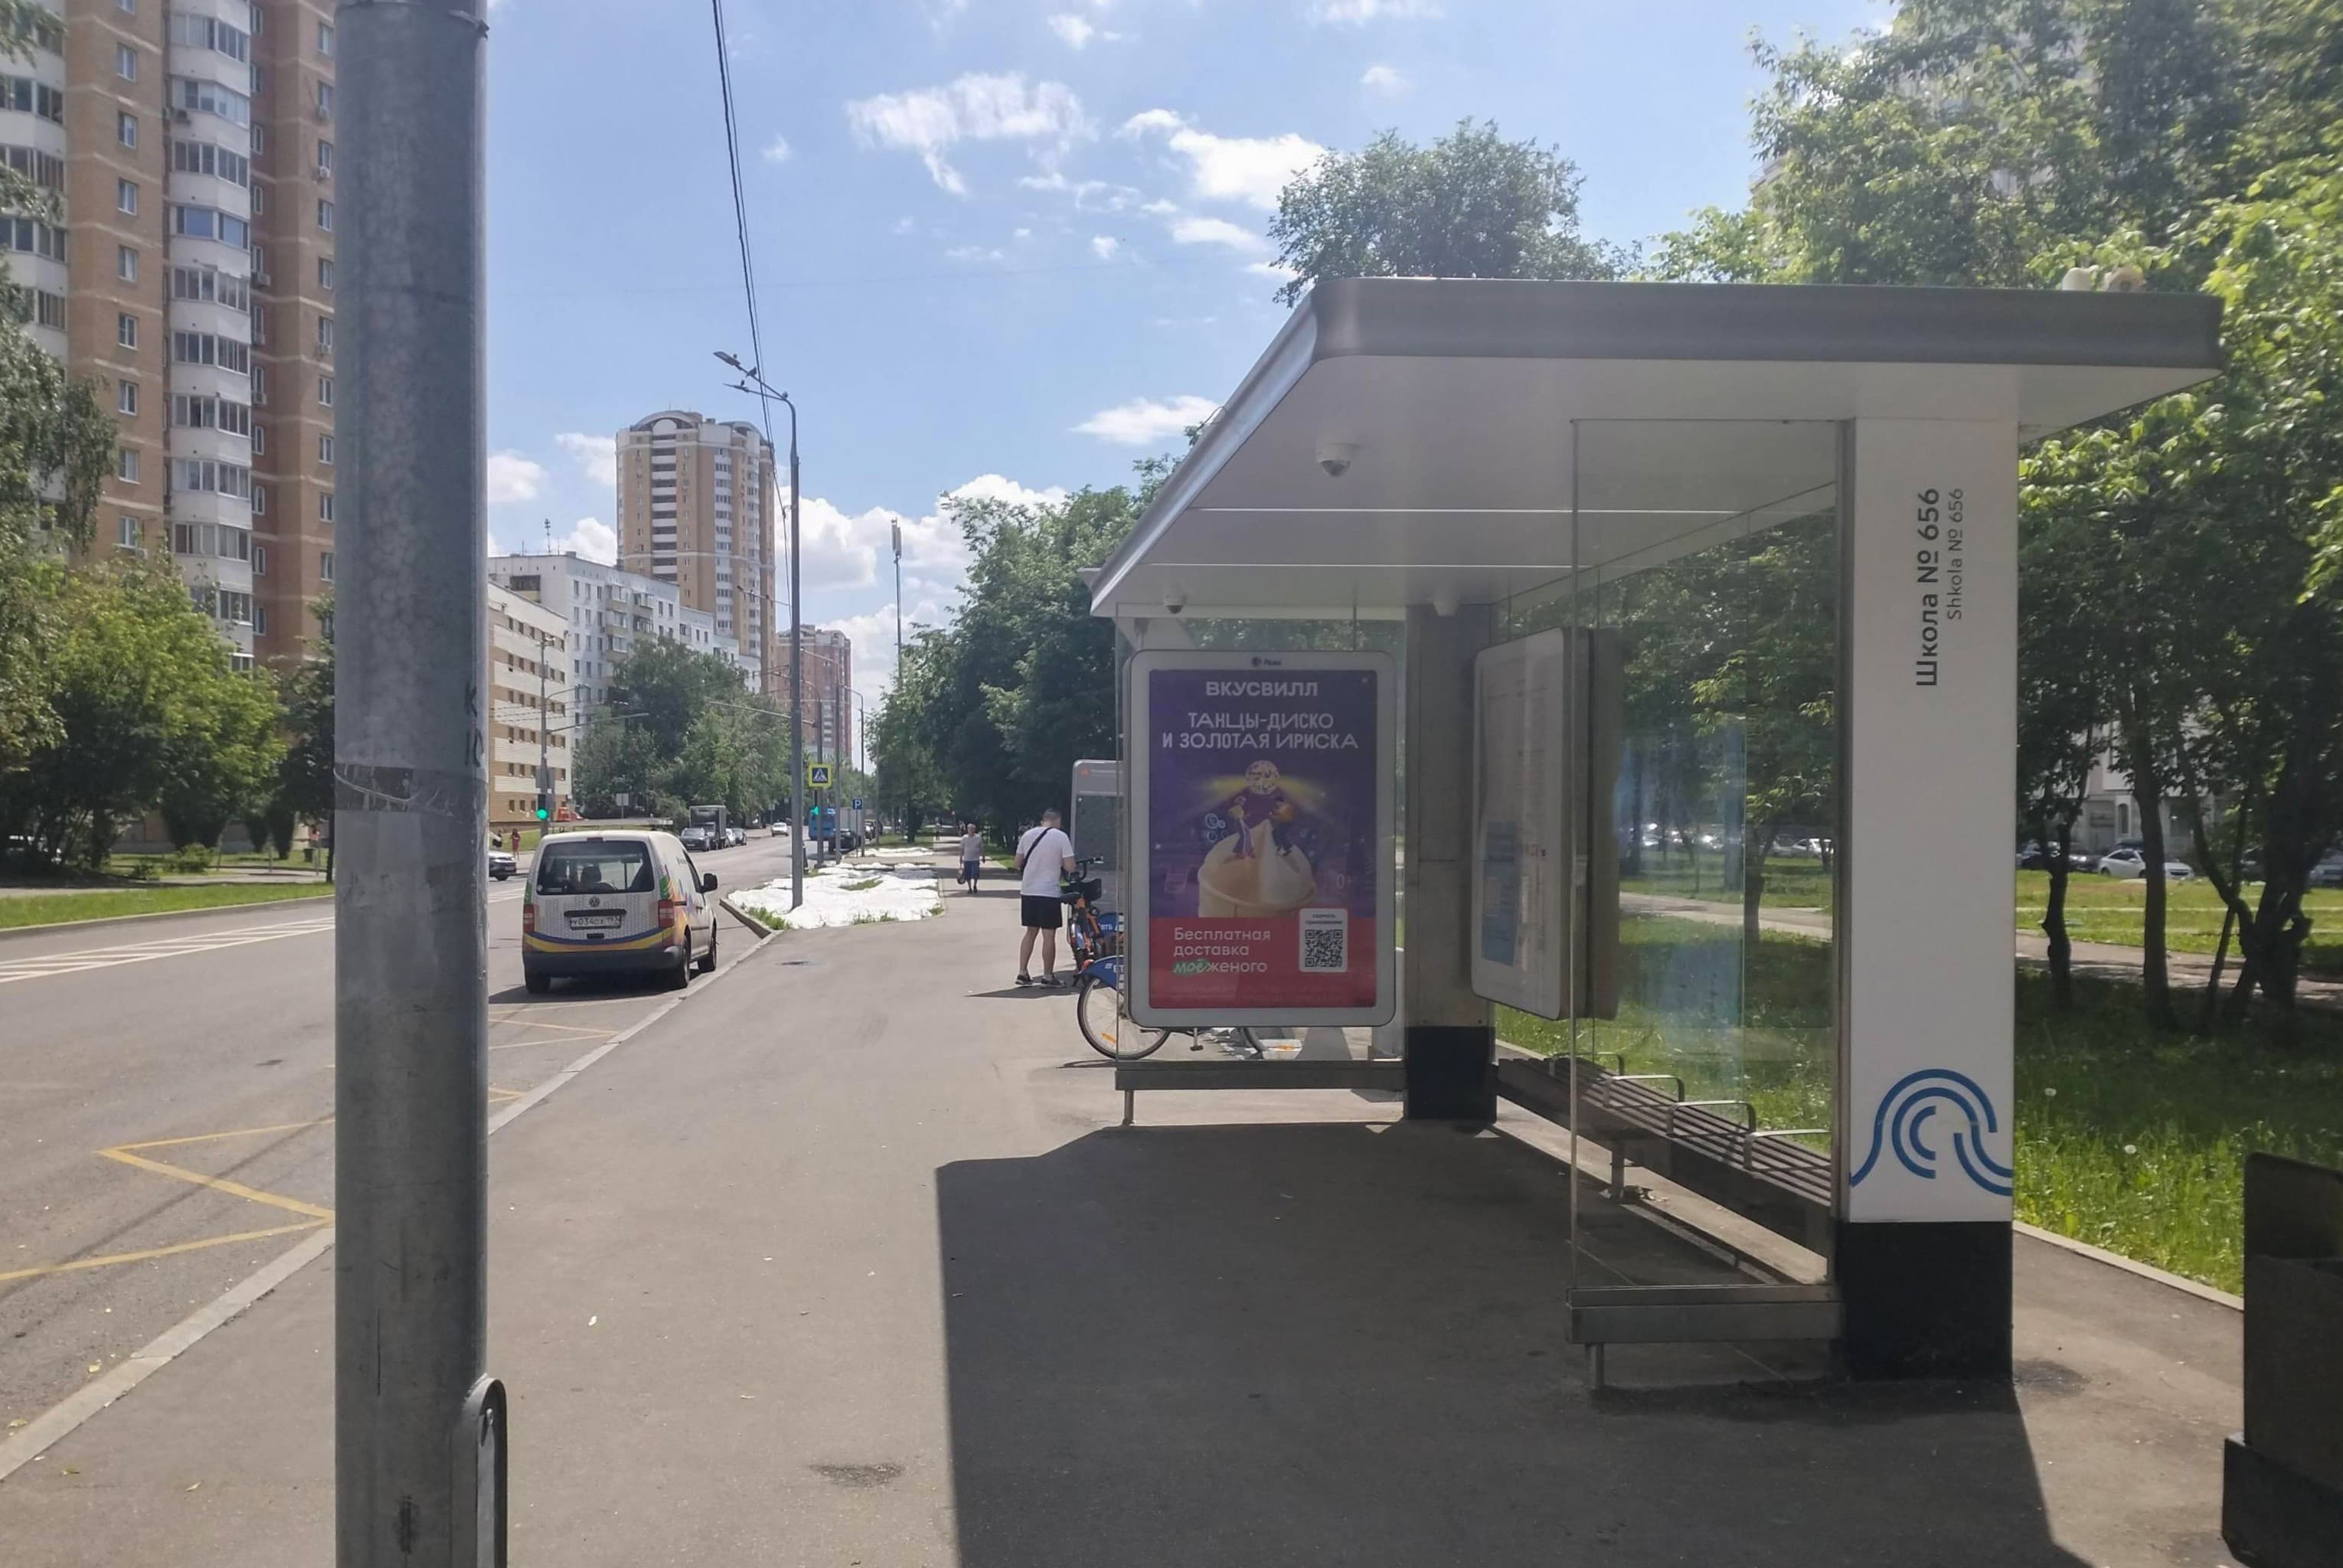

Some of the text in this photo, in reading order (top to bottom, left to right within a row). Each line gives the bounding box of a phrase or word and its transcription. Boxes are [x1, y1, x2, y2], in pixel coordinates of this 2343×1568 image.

[1946, 488, 1963, 619] Shkola № 656
[1916, 488, 1939, 686] Школа № 656
[1206, 681, 1318, 697] ВКУСВИЛЛ
[1188, 713, 1334, 730] ТАНЦЫ-ДИСКО
[1162, 733, 1359, 749] И ЗОЛОТАЯ ИРИСКА
[1174, 927, 1271, 941] Бесплатная
[1173, 944, 1249, 957] доставка
